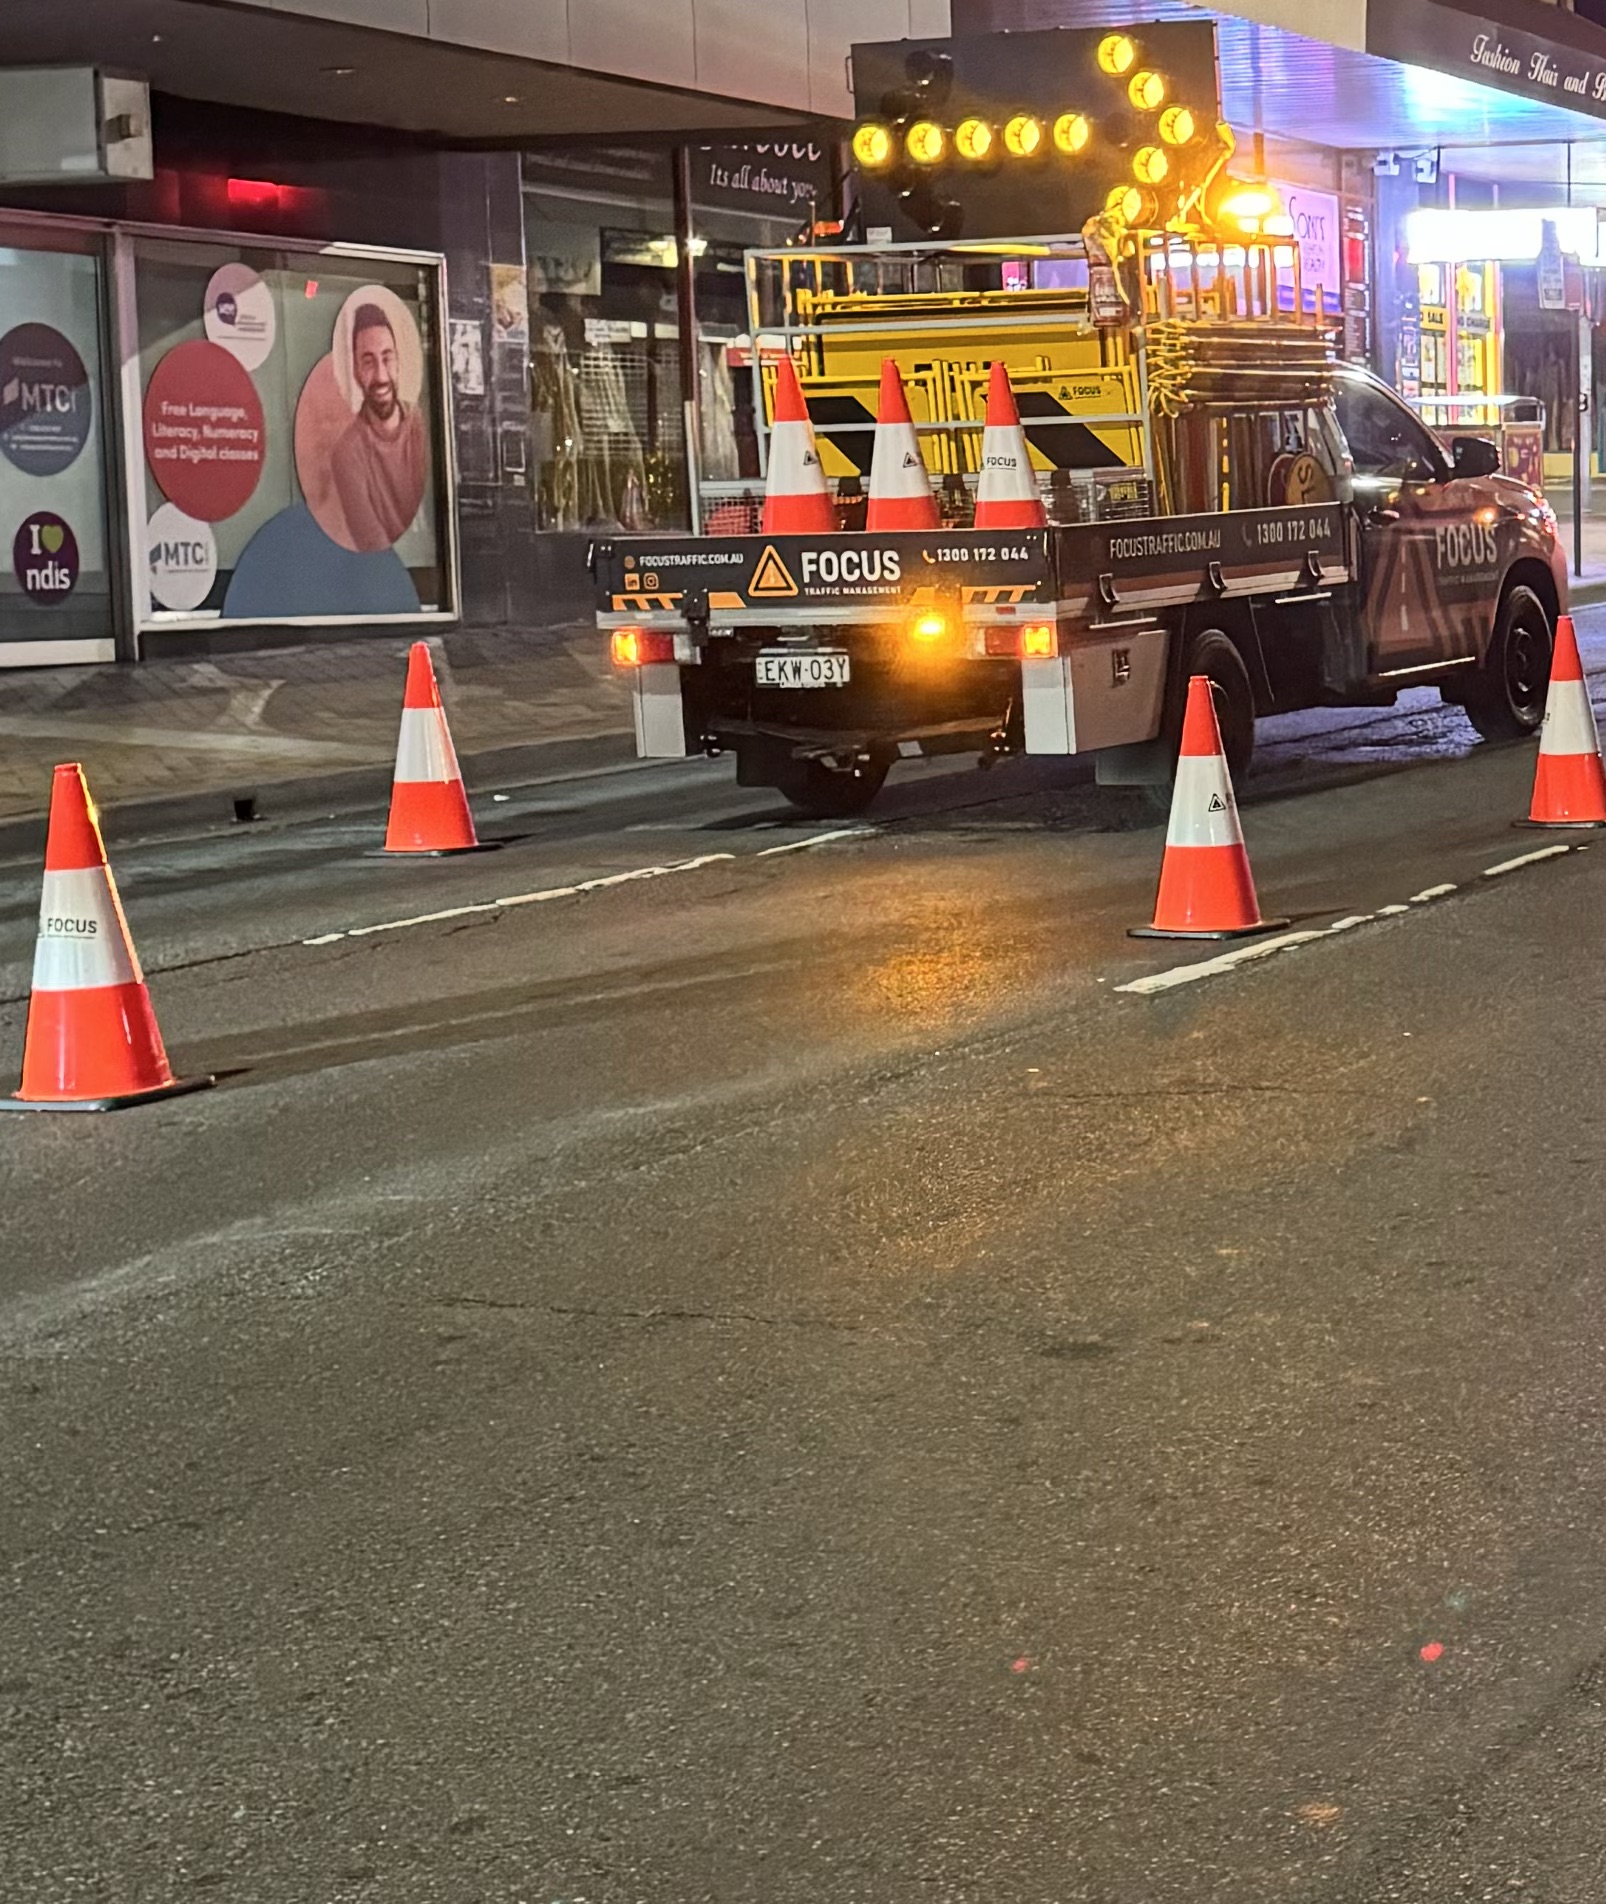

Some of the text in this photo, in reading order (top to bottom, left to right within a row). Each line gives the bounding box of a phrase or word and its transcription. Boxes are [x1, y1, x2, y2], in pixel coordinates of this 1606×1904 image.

[1470, 34, 1521, 75] Fashion
[1527, 52, 1559, 88] Hair
[1563, 71, 1590, 95] and
[731, 164, 752, 189] all
[751, 168, 788, 195] about
[20, 382, 71, 413] MTC
[1073, 385, 1102, 396] FOCUS
[161, 400, 249, 423] Free Language,
[202, 423, 259, 444] Numeracy
[154, 443, 178, 460] and
[179, 444, 218, 465] Digital
[986, 456, 1017, 468] FOCUS
[29, 523, 42, 556] I
[1256, 517, 1332, 545] 1300 172 044
[164, 542, 204, 567] MTC
[936, 546, 1029, 563] 1300 172 044
[1110, 529, 1221, 560] FOCUSTRAFFIC.COM.AU
[1435, 523, 1498, 569] FOCUS
[639, 553, 745, 568] FOCUSTRAFFIC.COM.AU
[801, 549, 902, 584] FOCUS
[26, 561, 71, 591] ndis
[804, 585, 902, 596] TRAFFIC MANAGEMENT
[47, 917, 98, 934] FOCUS
